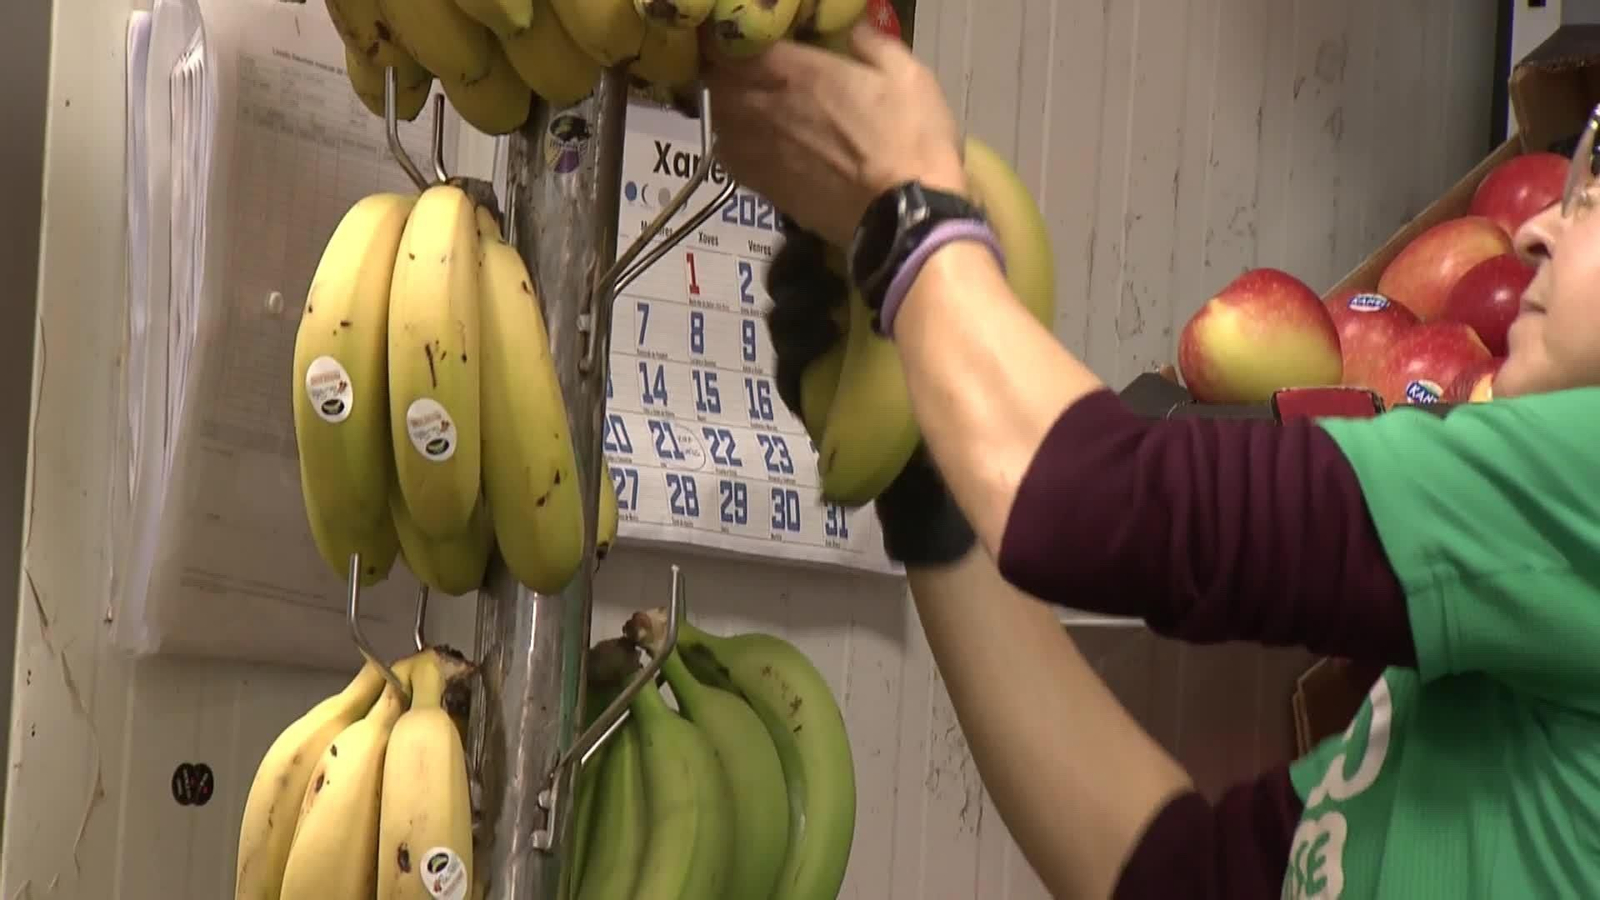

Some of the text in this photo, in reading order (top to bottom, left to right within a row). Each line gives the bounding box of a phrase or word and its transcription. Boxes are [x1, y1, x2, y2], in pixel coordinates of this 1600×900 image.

[653, 140, 726, 184] Xane
[698, 231, 719, 246] Xoves
[748, 240, 772, 256] Venres
[685, 252, 754, 304] 1 2
[637, 302, 756, 362] 7 8 9
[639, 362, 668, 406] 14
[692, 370, 721, 414] 15
[745, 378, 774, 422] 16
[649, 420, 685, 460] 21
[702, 427, 742, 467] 22
[757, 434, 794, 474] 23
[612, 467, 849, 540] 27 28 29 30 31
